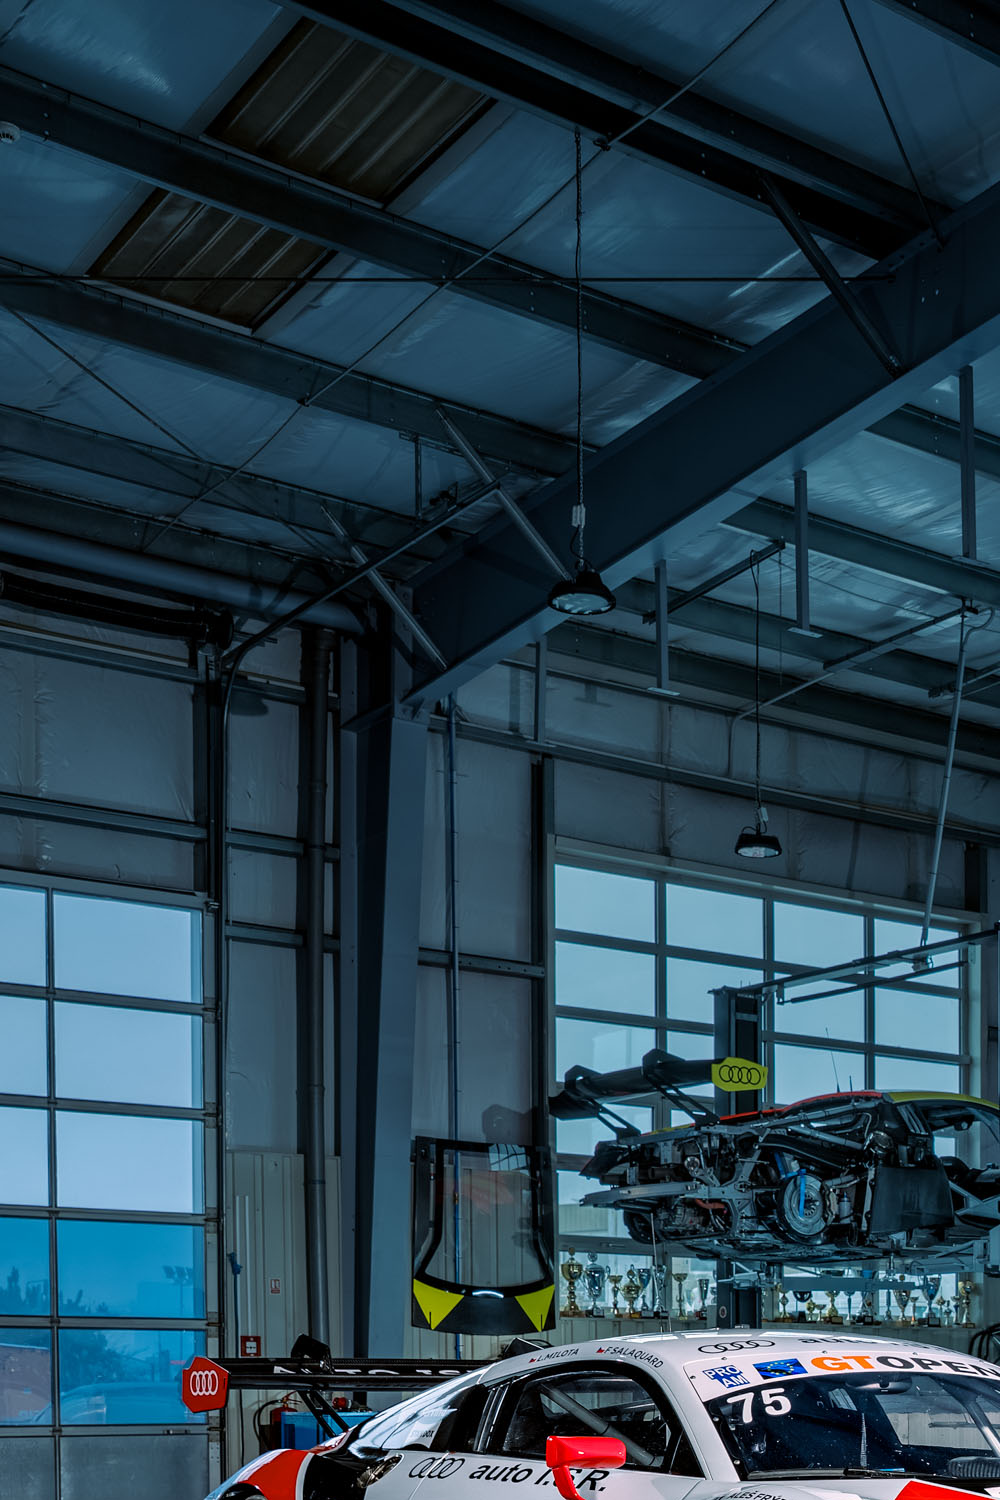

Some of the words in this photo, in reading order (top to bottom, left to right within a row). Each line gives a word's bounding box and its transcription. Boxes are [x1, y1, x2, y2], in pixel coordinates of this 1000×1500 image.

[537, 1348, 579, 1363] L.MILOTA
[704, 1364, 742, 1380] PRO
[722, 1374, 748, 1389] AM
[726, 1387, 792, 1424] 75
[469, 1464, 534, 1484] auto
